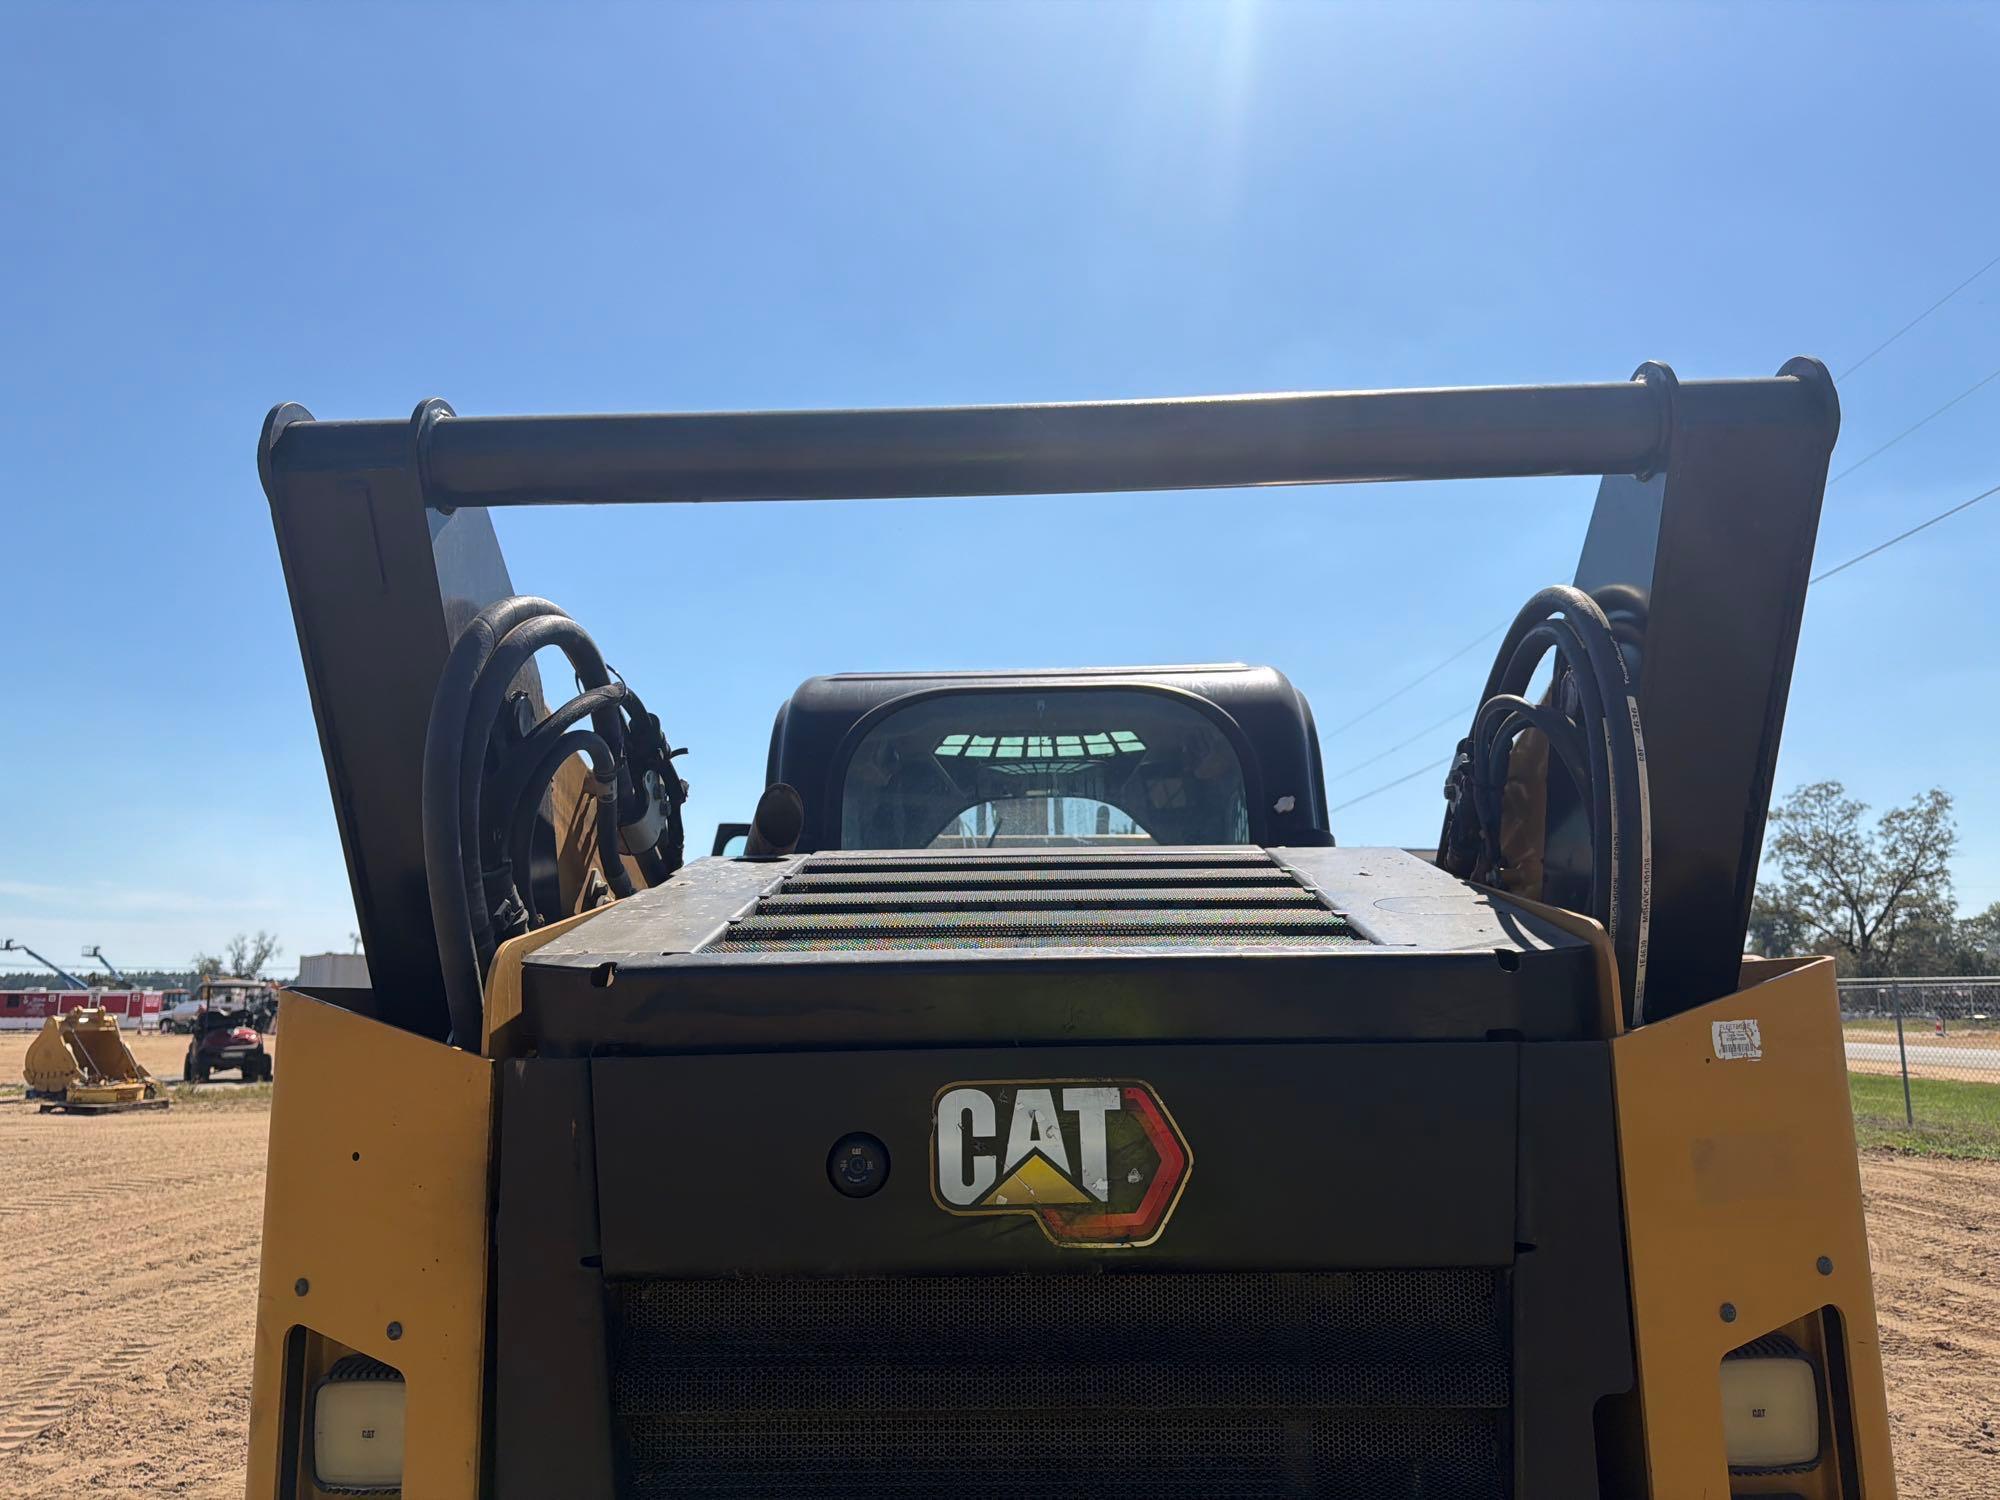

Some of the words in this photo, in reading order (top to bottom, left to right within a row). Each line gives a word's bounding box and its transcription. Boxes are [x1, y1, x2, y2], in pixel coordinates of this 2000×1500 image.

[937, 1087, 1121, 1206] CAT
[1752, 1408, 1766, 1418] CAT
[361, 1430, 375, 1439] CAT
